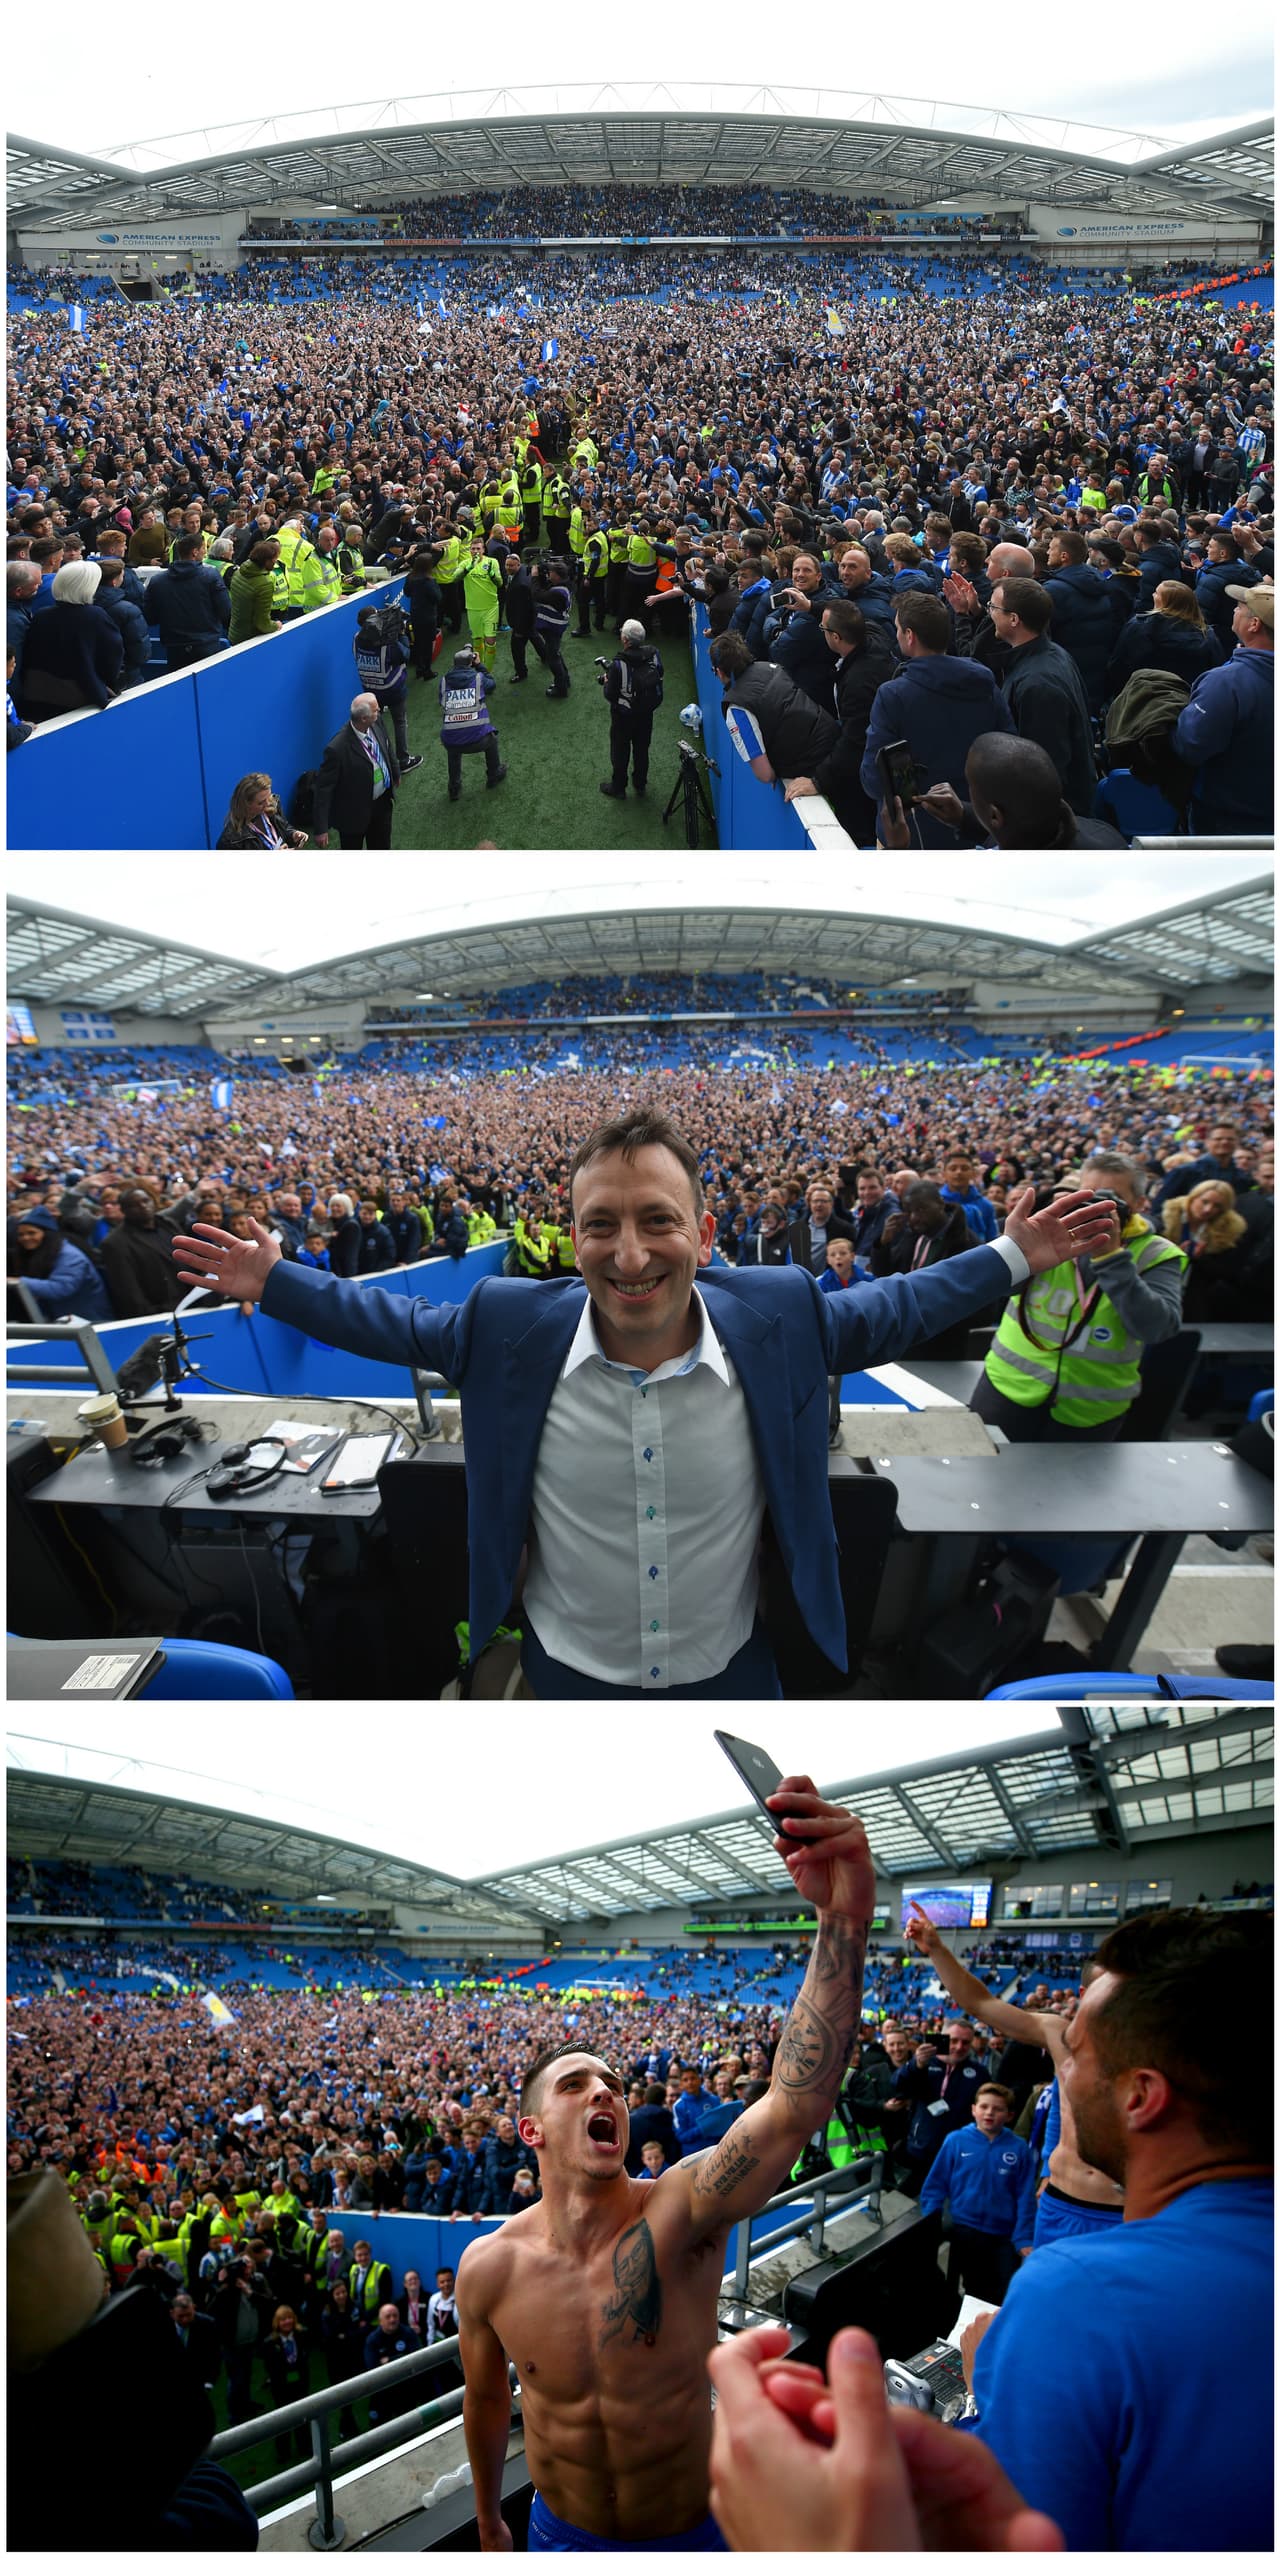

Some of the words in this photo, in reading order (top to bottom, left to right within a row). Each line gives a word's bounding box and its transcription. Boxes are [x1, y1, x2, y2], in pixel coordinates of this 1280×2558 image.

[1136, 223, 1185, 231] EXPRESS
[1080, 230, 1130, 238] COMMUNITY
[1135, 229, 1175, 237] STADIUM
[357, 655, 380, 666] PARK
[446, 689, 475, 701] PARK
[447, 713, 473, 721] Canon
